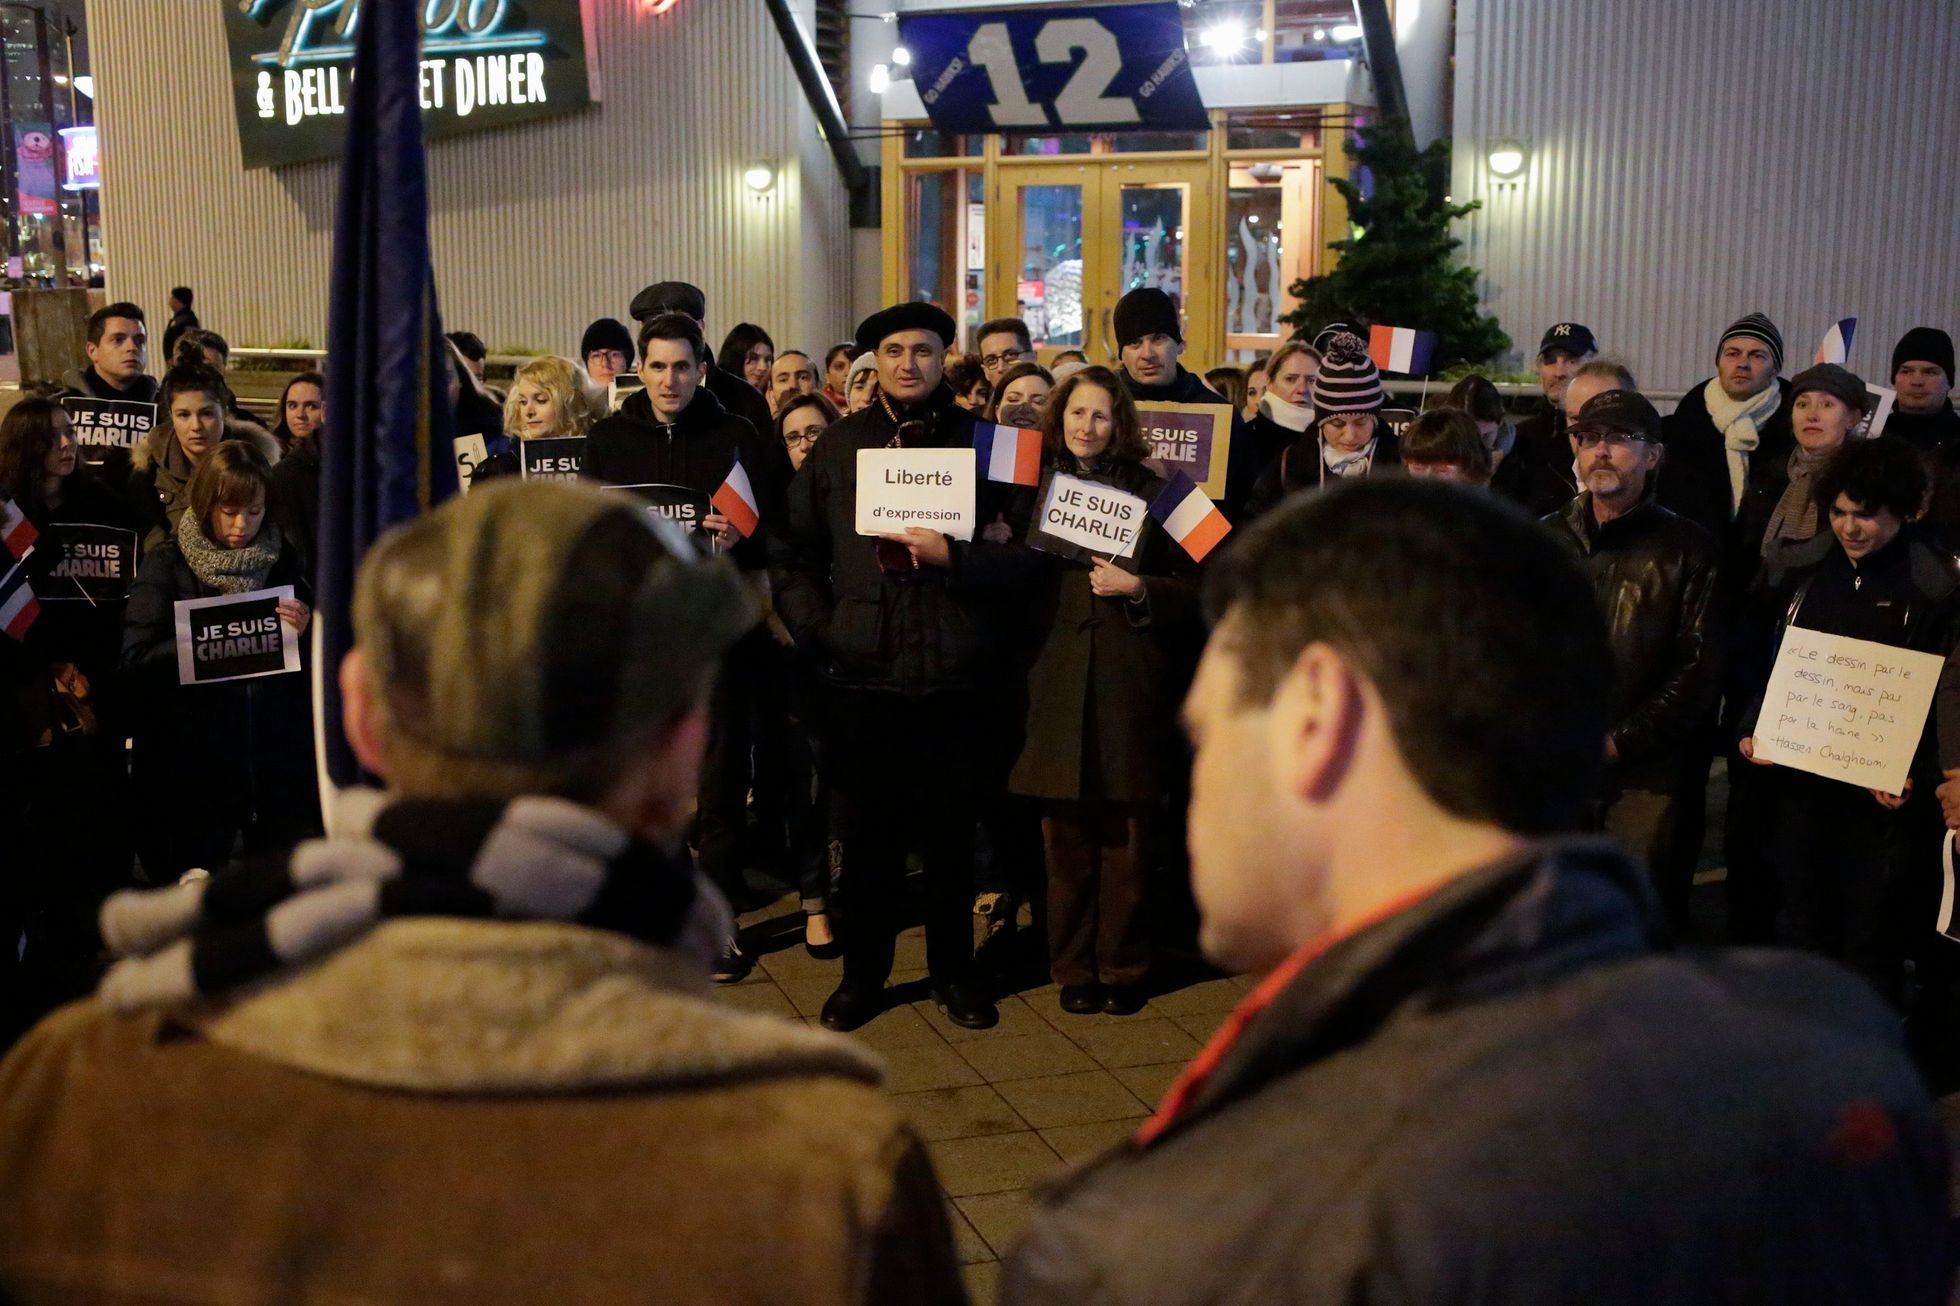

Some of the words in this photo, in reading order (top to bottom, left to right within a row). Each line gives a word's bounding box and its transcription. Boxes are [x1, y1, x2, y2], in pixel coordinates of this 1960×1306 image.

[967, 17, 1142, 126] 12
[257, 71, 275, 118] &
[284, 66, 345, 126] BELL
[456, 53, 547, 116] DINER
[72, 410, 95, 425] JE
[98, 412, 150, 430] SUIS
[1151, 427, 1198, 443] SUIS
[529, 458, 555, 472] JE
[885, 468, 953, 486] Liberté
[1058, 488, 1084, 507] JE
[1086, 495, 1133, 521] SUIS
[1047, 508, 1133, 543] CHARLIE
[74, 544, 120, 558] SUIS
[50, 559, 121, 578] HARLIE
[196, 625, 224, 641] JE
[227, 617, 278, 637] SUIS
[196, 633, 280, 662] CHARLIE
[1826, 653, 1867, 670] dessin
[1874, 663, 1893, 678] par
[1898, 666, 1913, 680] le
[1843, 683, 1875, 696] mais
[1878, 692, 1903, 706] pas
[1786, 691, 1808, 708] par
[1813, 694, 1824, 707] le
[1867, 710, 1896, 725] pas
[1779, 714, 1798, 730] par
[1806, 716, 1820, 731] la
